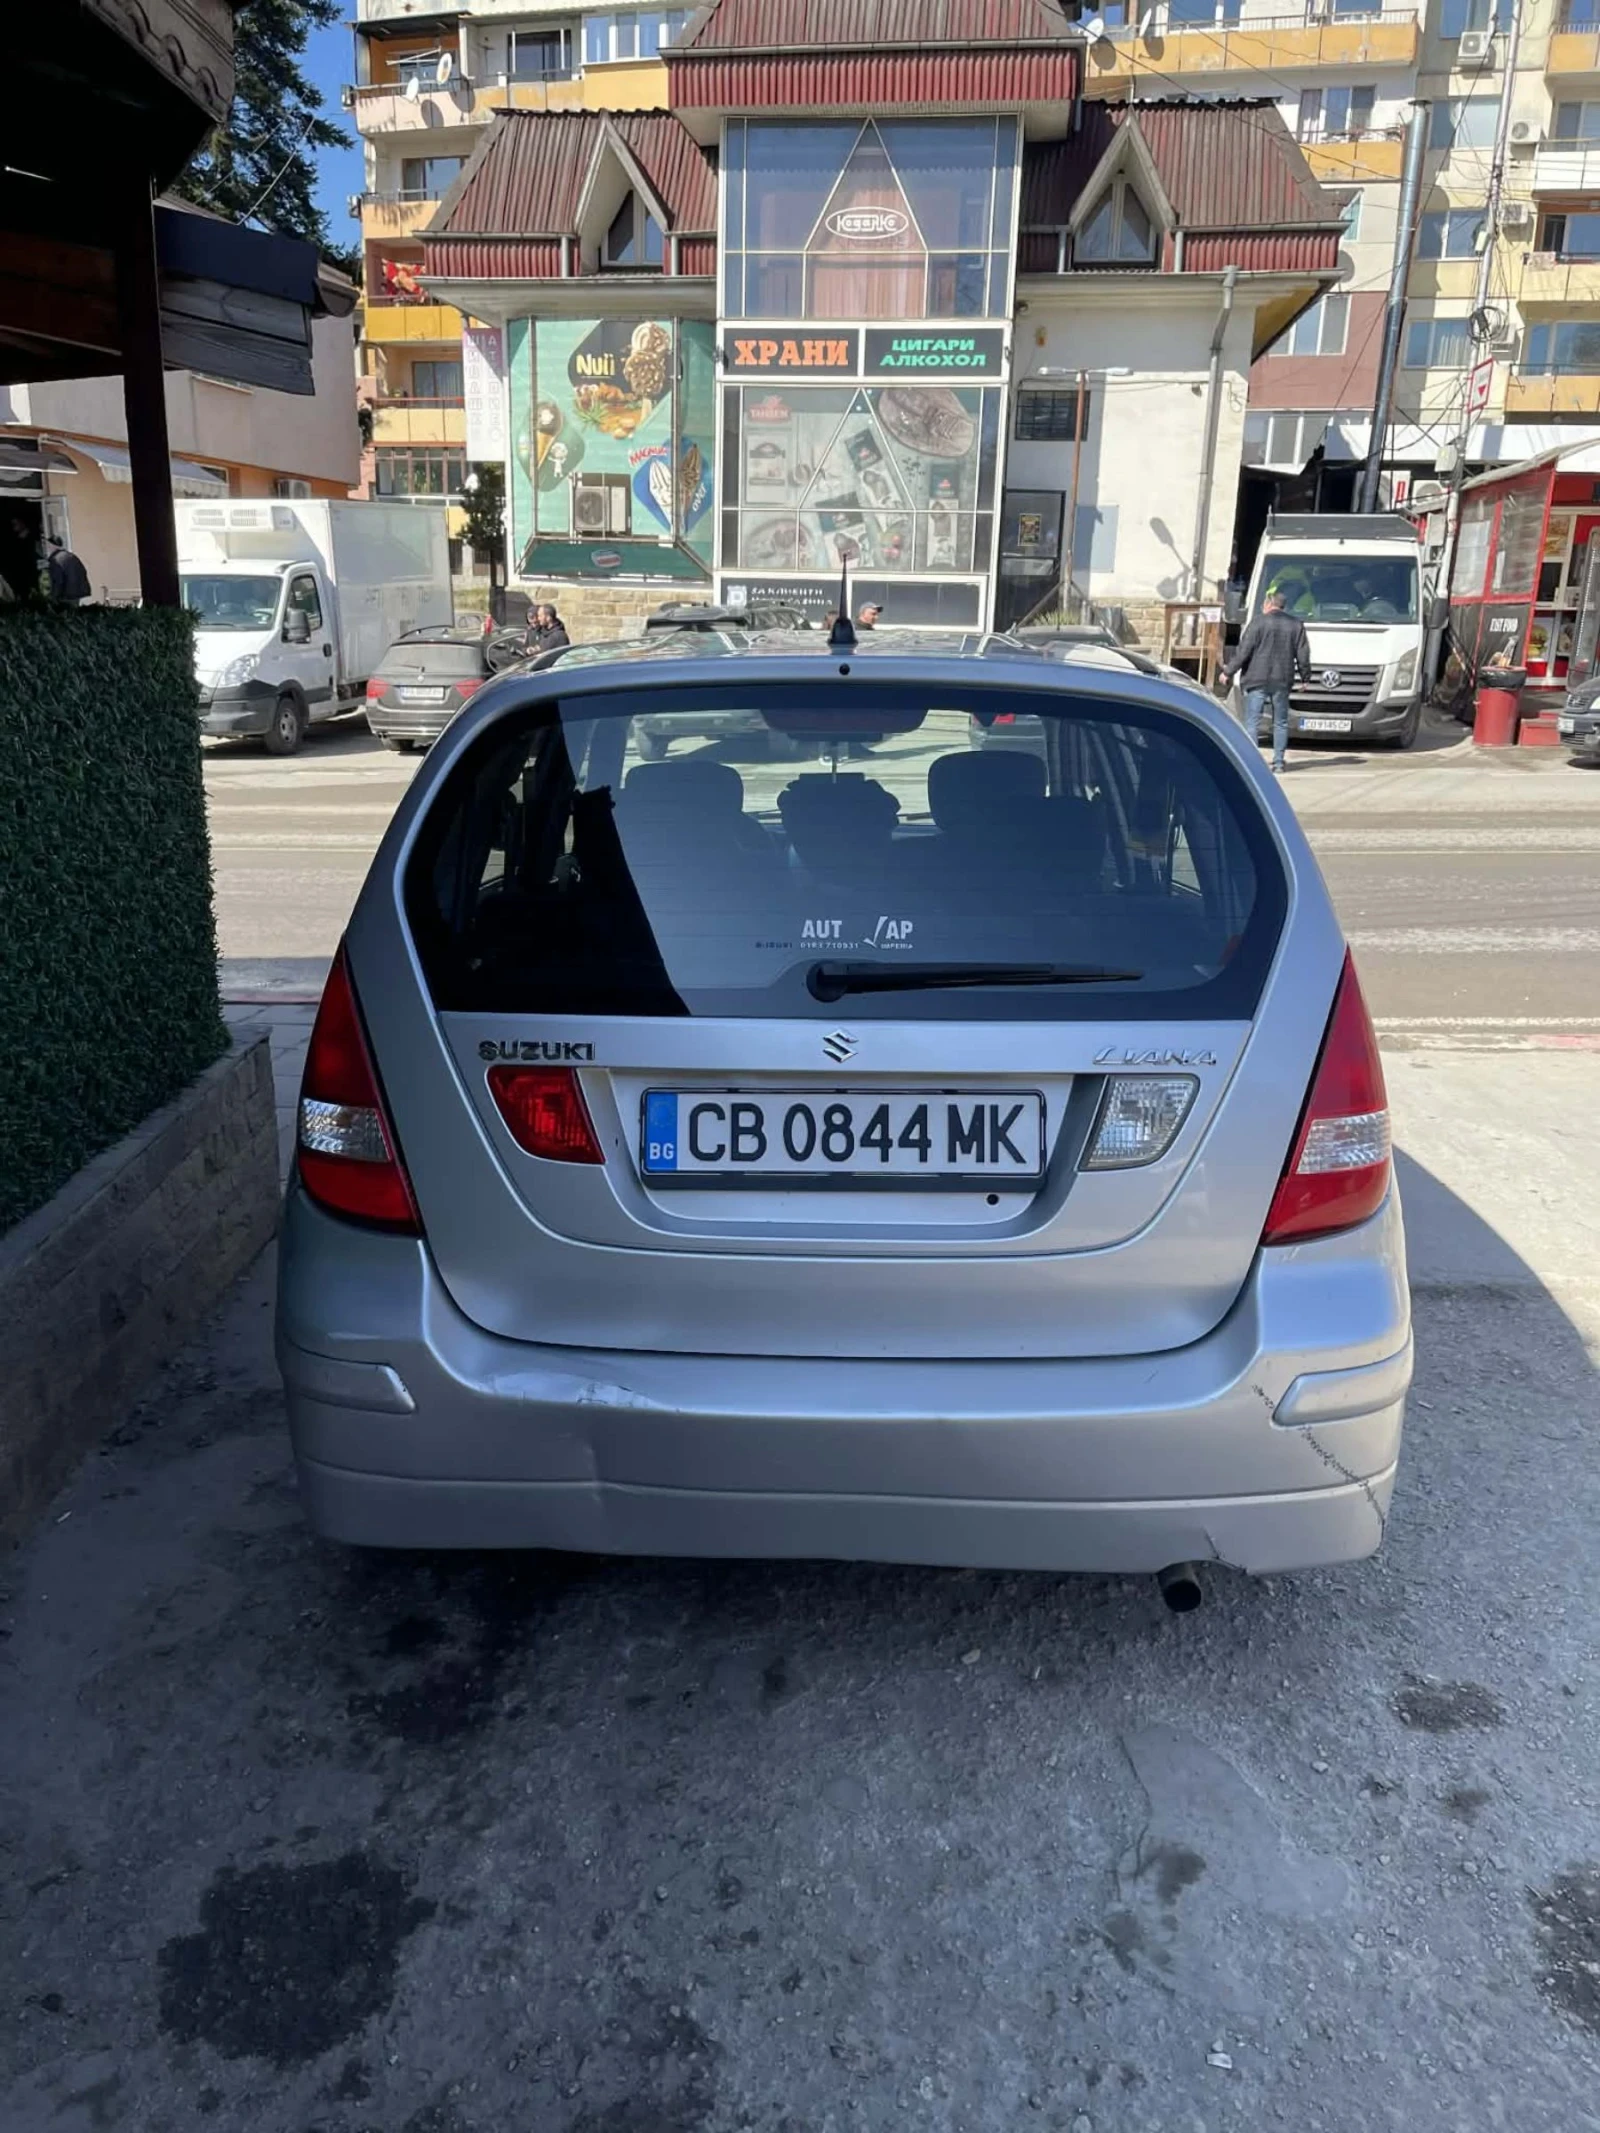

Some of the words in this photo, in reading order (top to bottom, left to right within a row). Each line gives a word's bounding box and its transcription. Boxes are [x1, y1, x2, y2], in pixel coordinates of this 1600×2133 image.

[734, 340, 849, 366] ХРАНИ
[892, 339, 975, 352] ЦИГАРИ
[880, 354, 986, 367] АЛКОХОЛ
[478, 1040, 596, 1061] SUZUKI
[1093, 1046, 1217, 1066] LIANA
[689, 1102, 767, 1162] CB
[783, 1103, 932, 1163] 0844
[947, 1103, 1027, 1164] MK
[649, 1142, 675, 1160] BG
